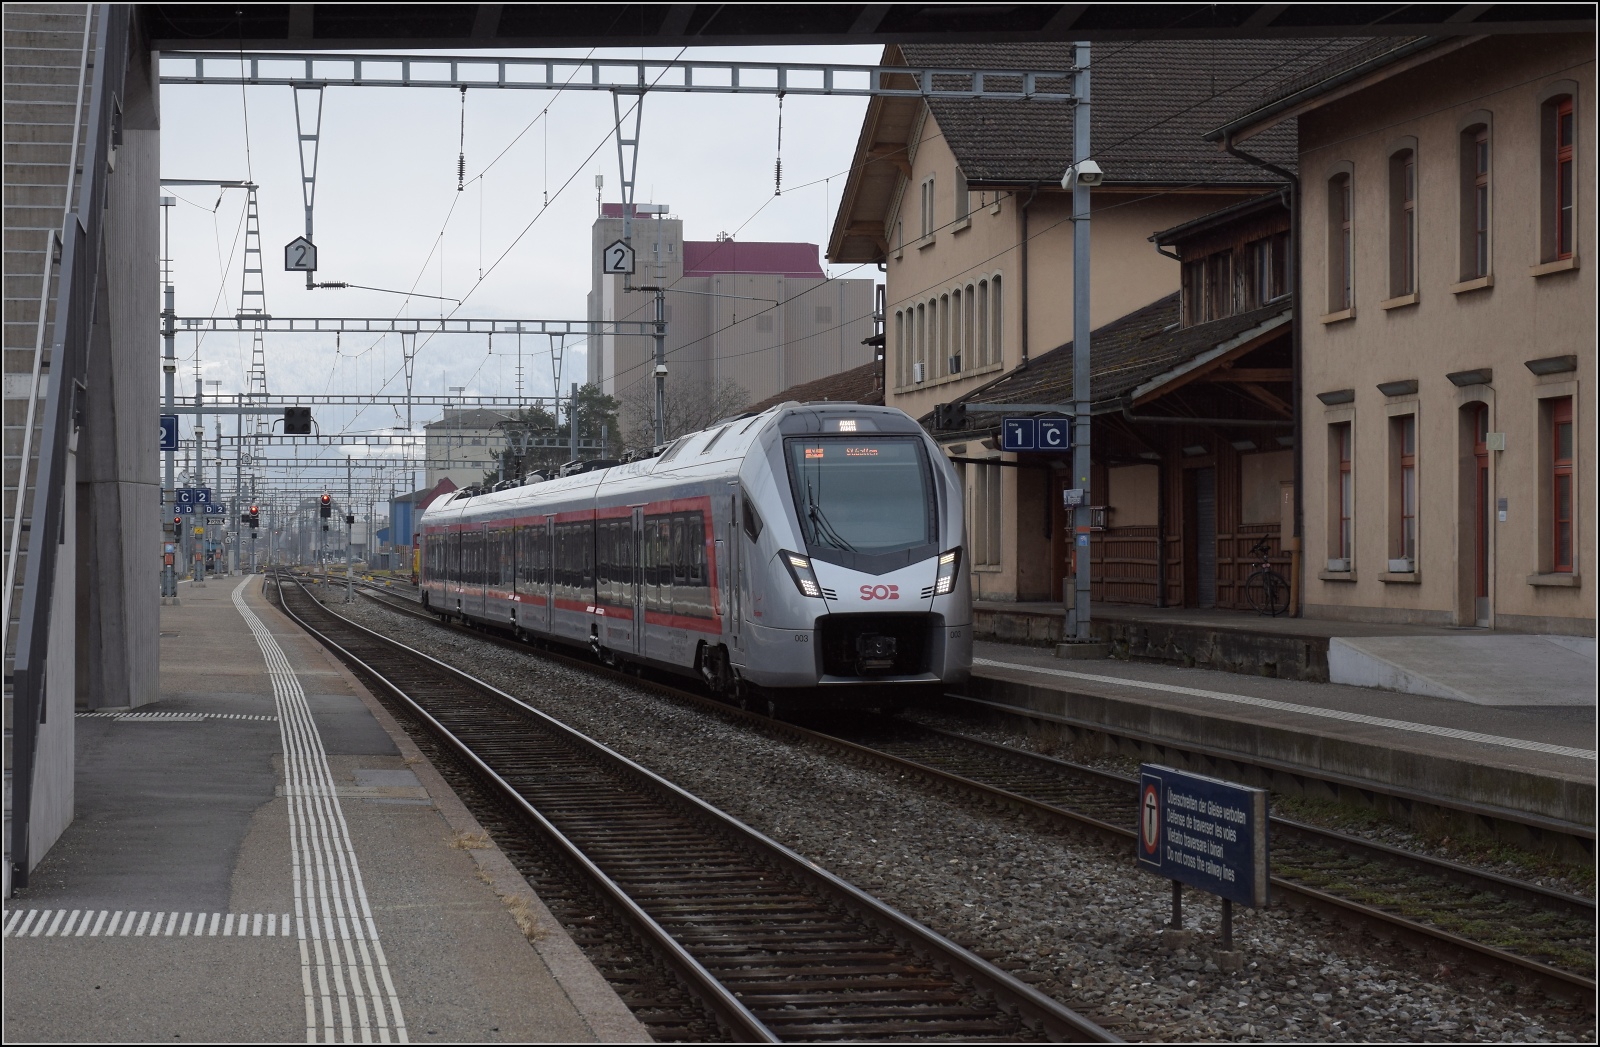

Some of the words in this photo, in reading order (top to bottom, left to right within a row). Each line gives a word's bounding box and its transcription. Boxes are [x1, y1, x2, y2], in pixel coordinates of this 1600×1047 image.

[295, 245, 306, 267] 2
[613, 248, 625, 270] 2
[1014, 427, 1023, 445] 1
[1046, 428, 1061, 446] C
[181, 493, 189, 502] C
[198, 493, 206, 502] 2
[860, 584, 900, 601] SOB
[794, 634, 809, 643] 003
[950, 630, 962, 639] 003
[1167, 786, 1198, 811] Überschreiten
[1198, 798, 1207, 810] der
[1207, 800, 1223, 819] Gleise
[1223, 806, 1247, 824] verboten
[1166, 808, 1186, 828] Défense
[1185, 813, 1193, 828] de
[1193, 816, 1215, 836] traverser
[1214, 822, 1223, 838] les
[1222, 826, 1237, 842] voies
[1166, 826, 1183, 845] Vietato
[1183, 832, 1207, 853] traversare
[1209, 840, 1224, 859] binari
[1166, 845, 1174, 860] Do
[1174, 850, 1183, 864] not
[1182, 853, 1197, 869] cross
[1196, 855, 1205, 871] the
[1205, 857, 1223, 880] railway
[1222, 864, 1235, 882] lines
